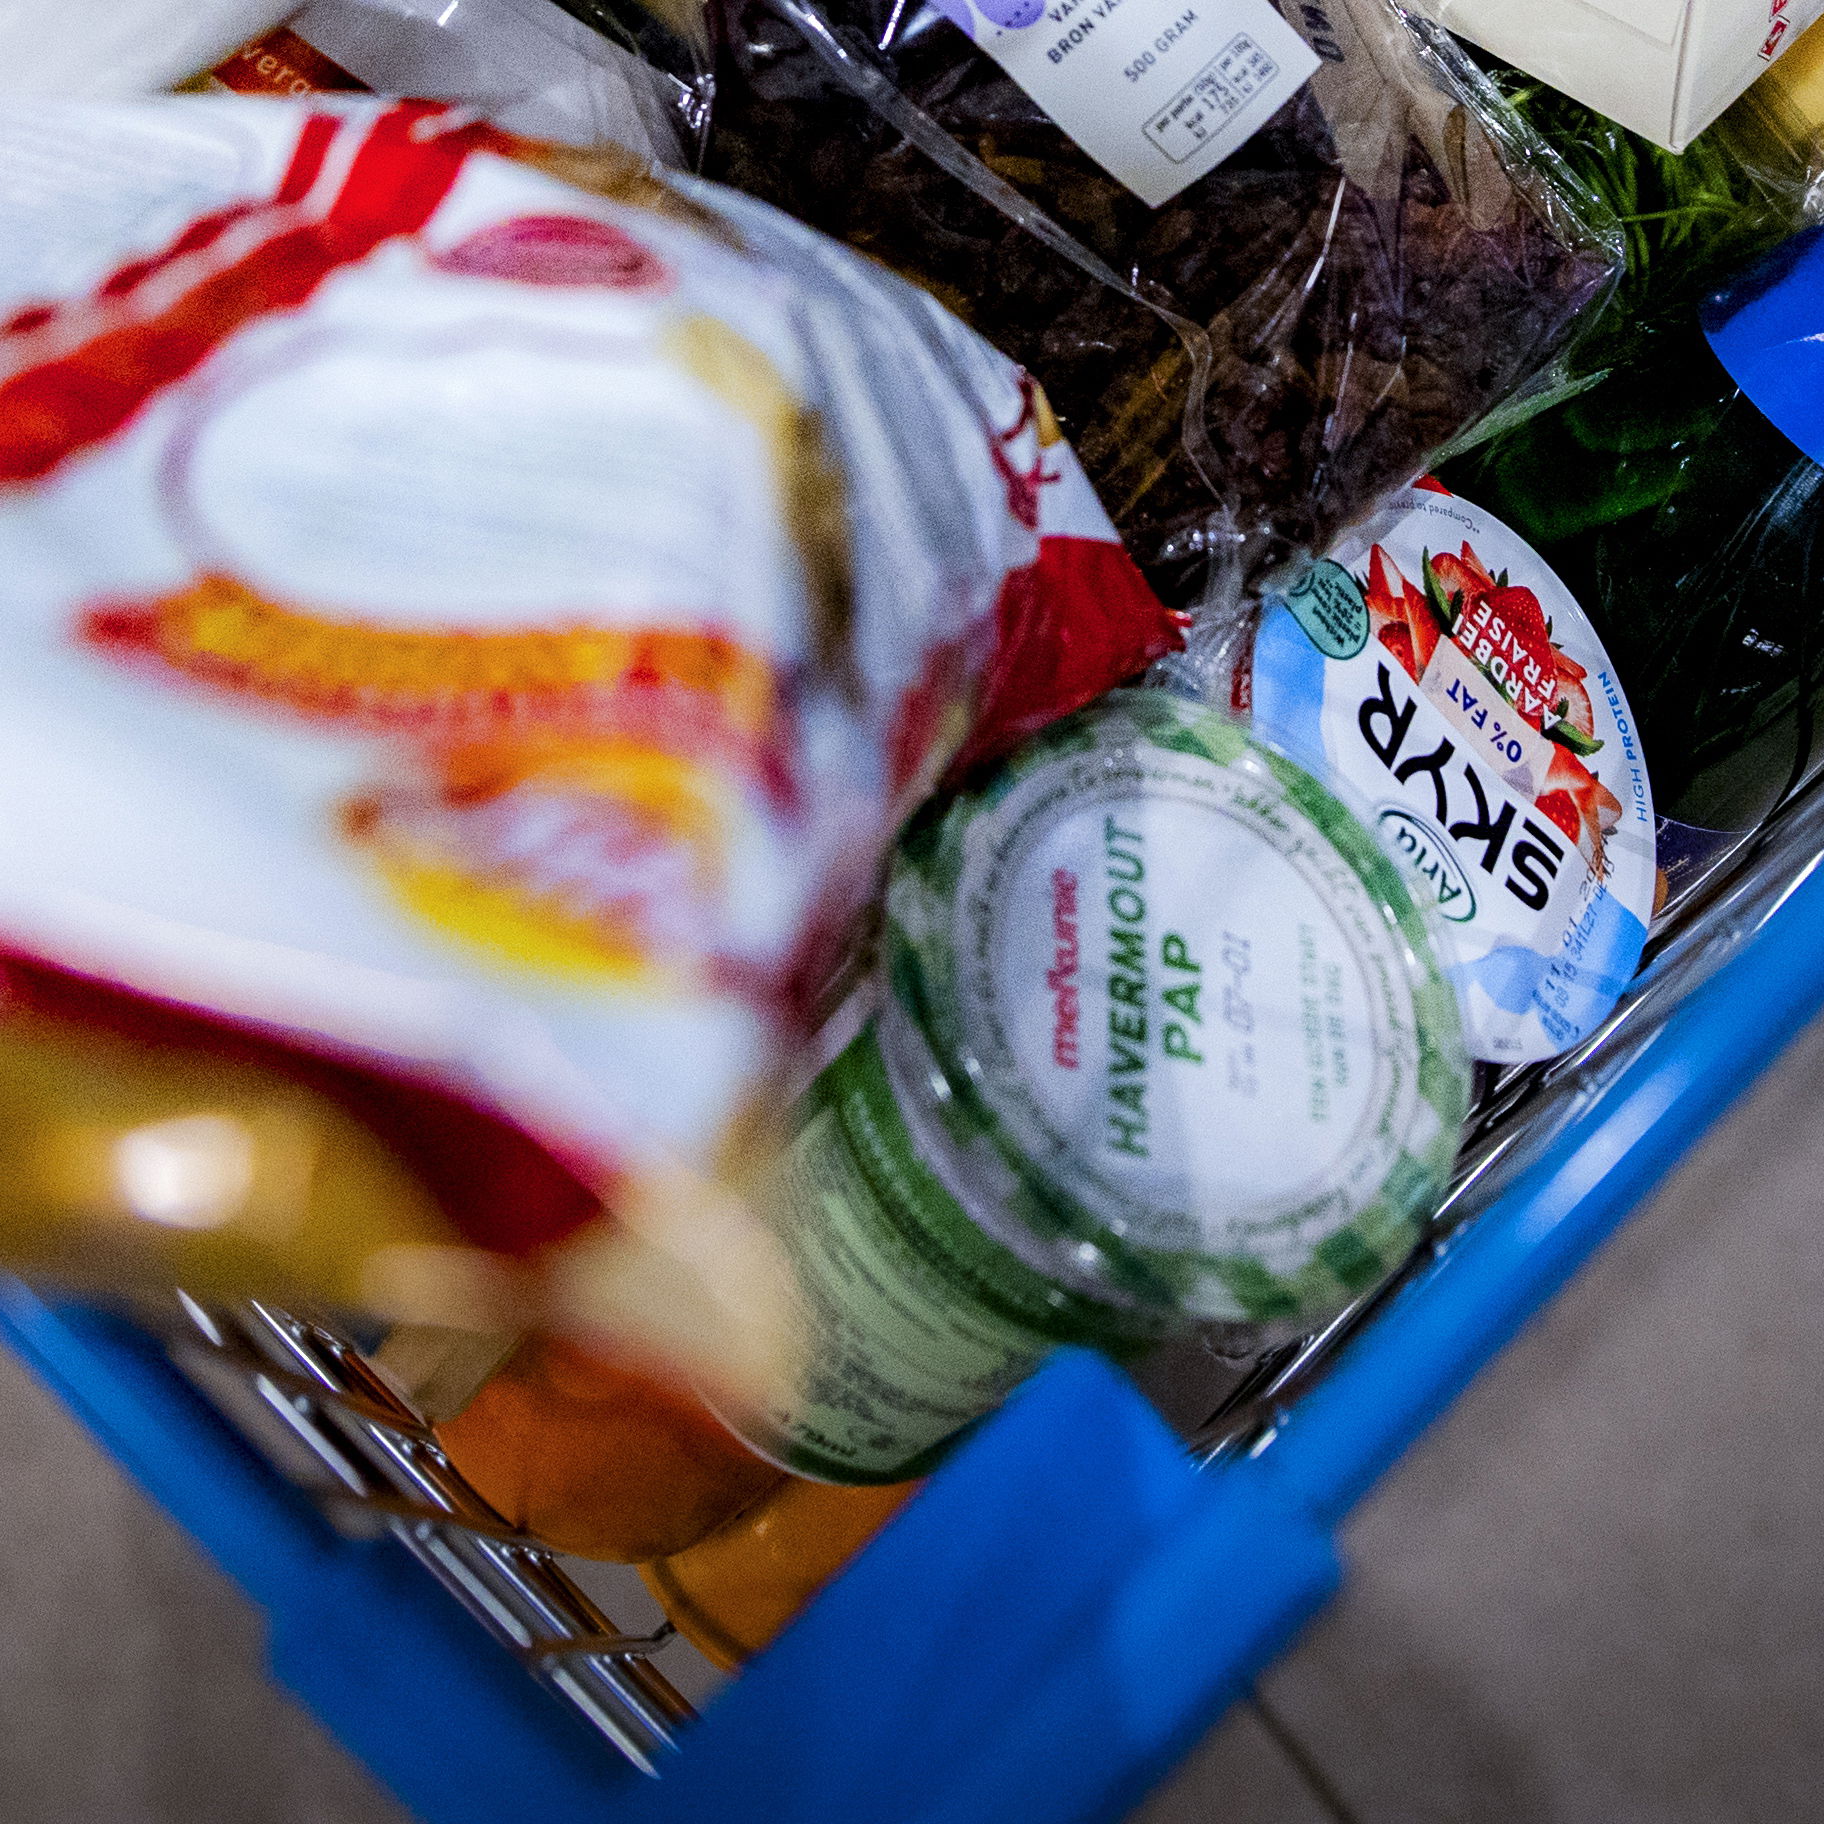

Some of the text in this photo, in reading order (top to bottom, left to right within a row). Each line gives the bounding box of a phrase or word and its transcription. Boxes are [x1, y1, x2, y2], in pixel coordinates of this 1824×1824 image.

[1047, 18, 1095, 65] BRON
[1123, 49, 1156, 84] 500
[1153, 8, 1201, 54] GRAM
[1451, 611, 1561, 730] AARDBEI
[1472, 598, 1557, 705] FRAISE
[1446, 675, 1524, 765] 0% FAT
[1598, 671, 1651, 824] HIGH PROTEIN
[1357, 660, 1567, 912] SKYR
[1391, 823, 1462, 907] Arla
[1103, 813, 1151, 1160] HAVERMOUT
[1159, 931, 1206, 1067] PAP
